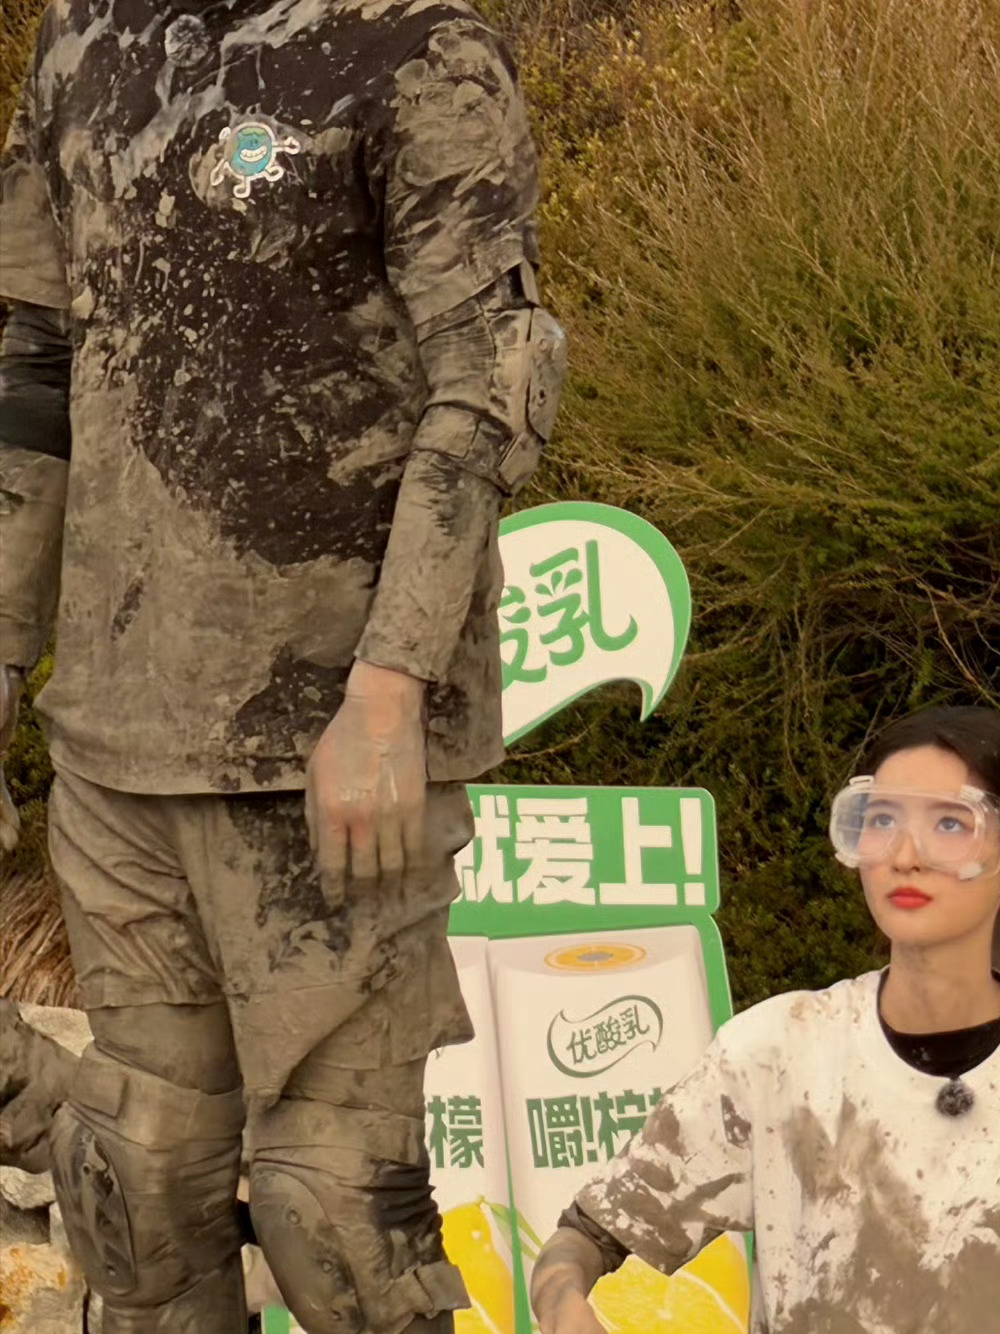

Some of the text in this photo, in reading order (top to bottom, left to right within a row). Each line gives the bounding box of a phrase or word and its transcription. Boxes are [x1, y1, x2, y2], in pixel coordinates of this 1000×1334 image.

[565, 1004, 651, 1065] 优酸乳
[526, 1086, 663, 1169] 嚼!柠
